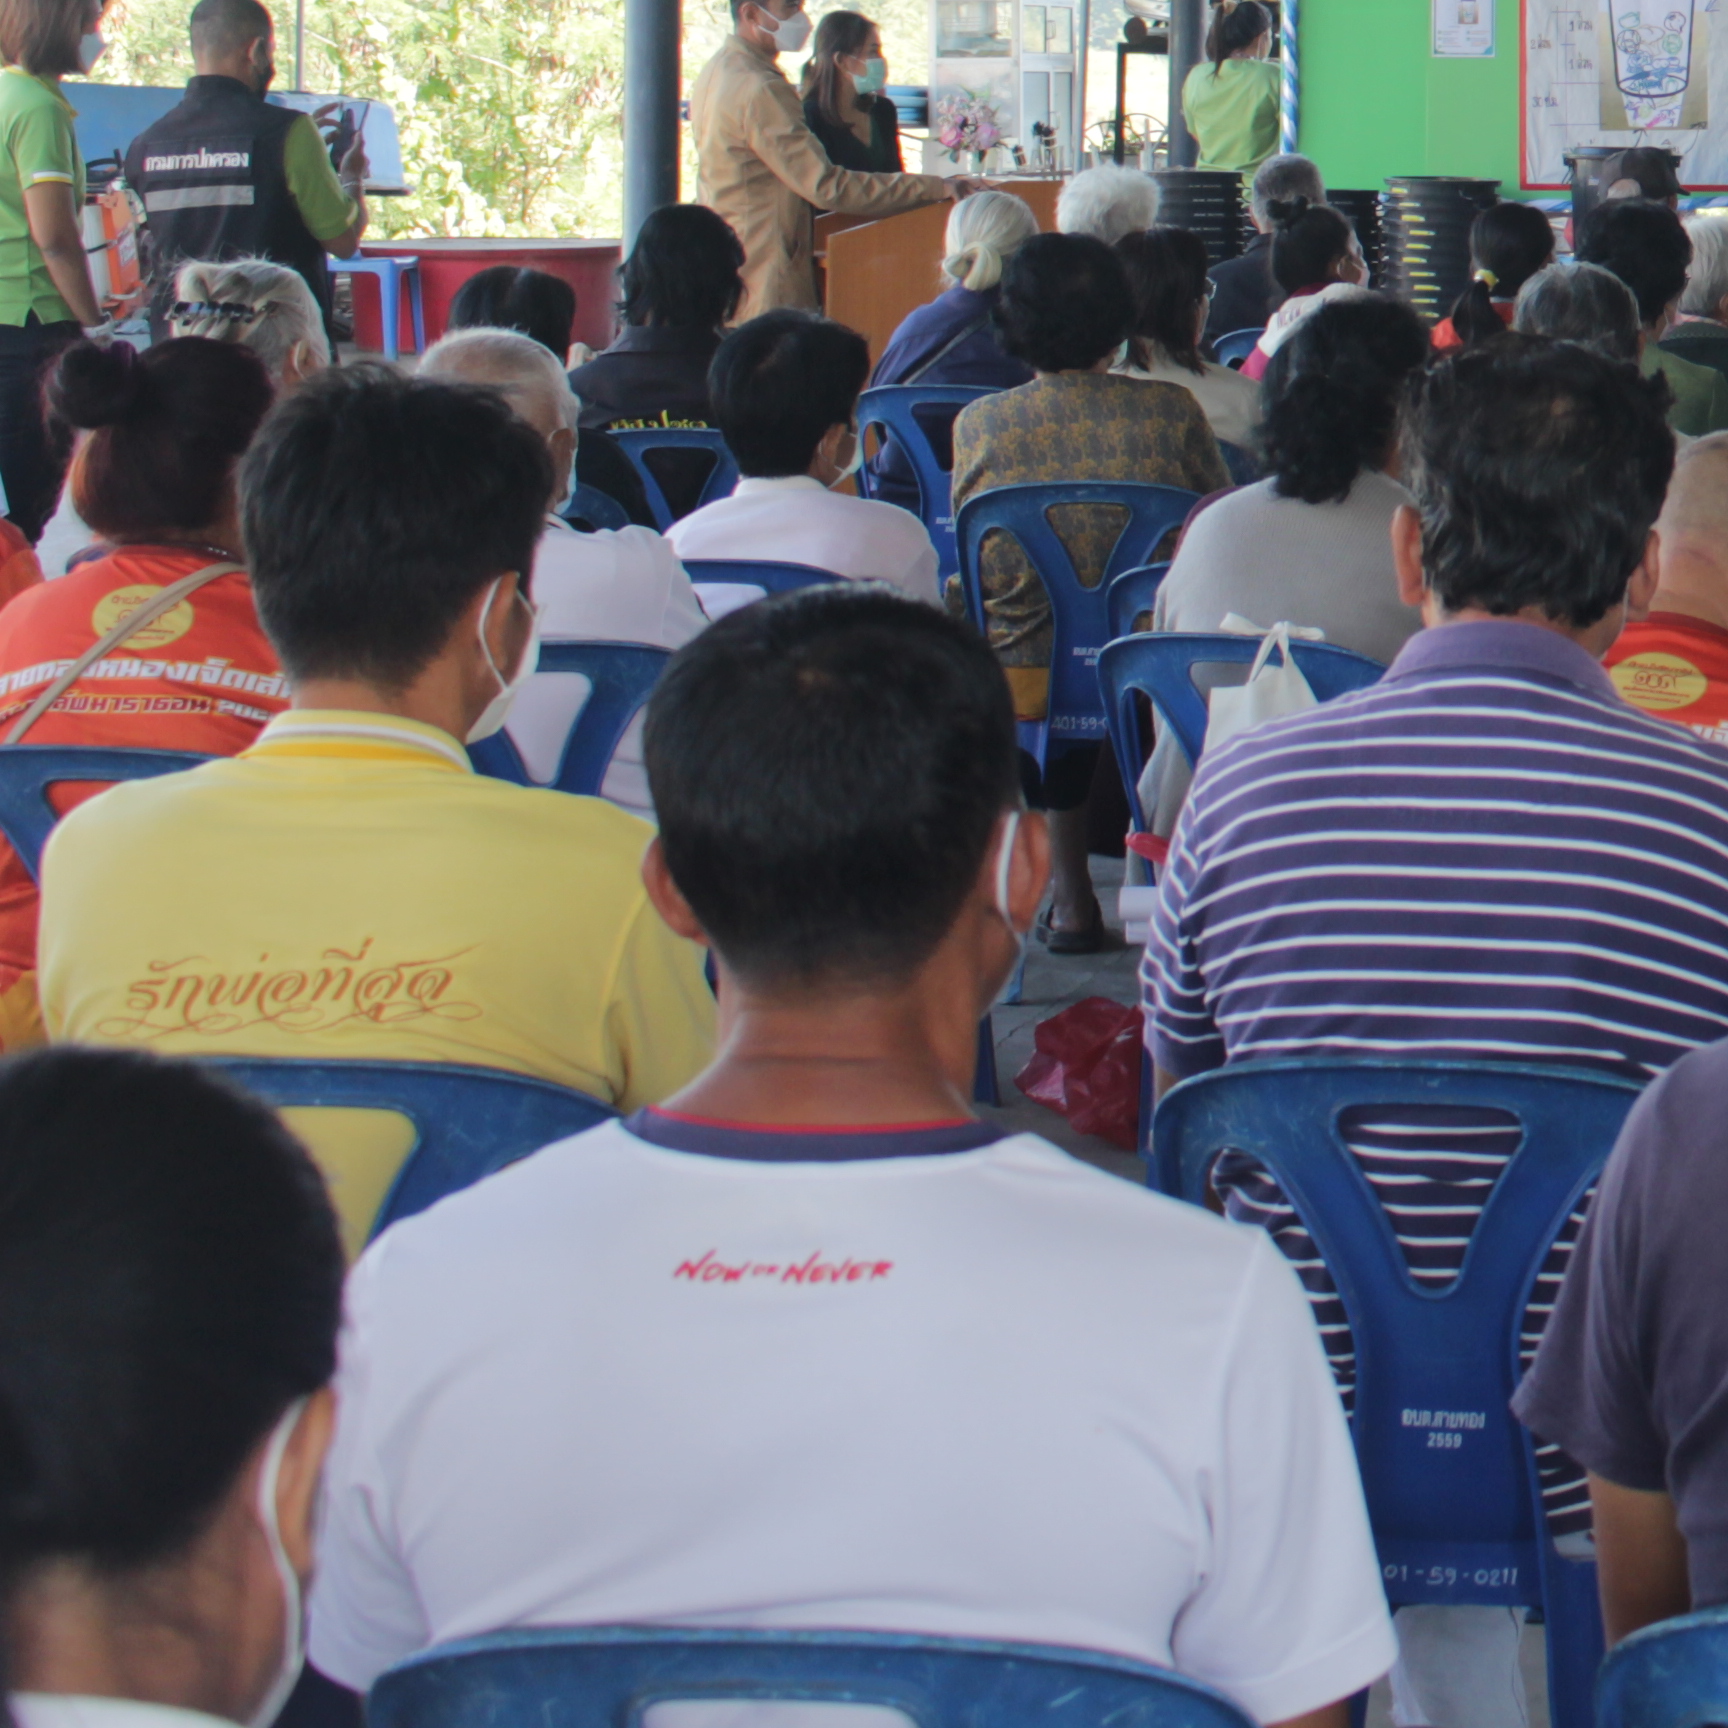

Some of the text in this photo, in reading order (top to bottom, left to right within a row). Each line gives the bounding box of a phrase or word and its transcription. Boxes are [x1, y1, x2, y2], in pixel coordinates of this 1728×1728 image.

[144, 147, 250, 172] กรมการปกครอง
[673, 1248, 751, 1283] NOW
[781, 1250, 895, 1284] NEVER
[1427, 1432, 1463, 1449] 2559
